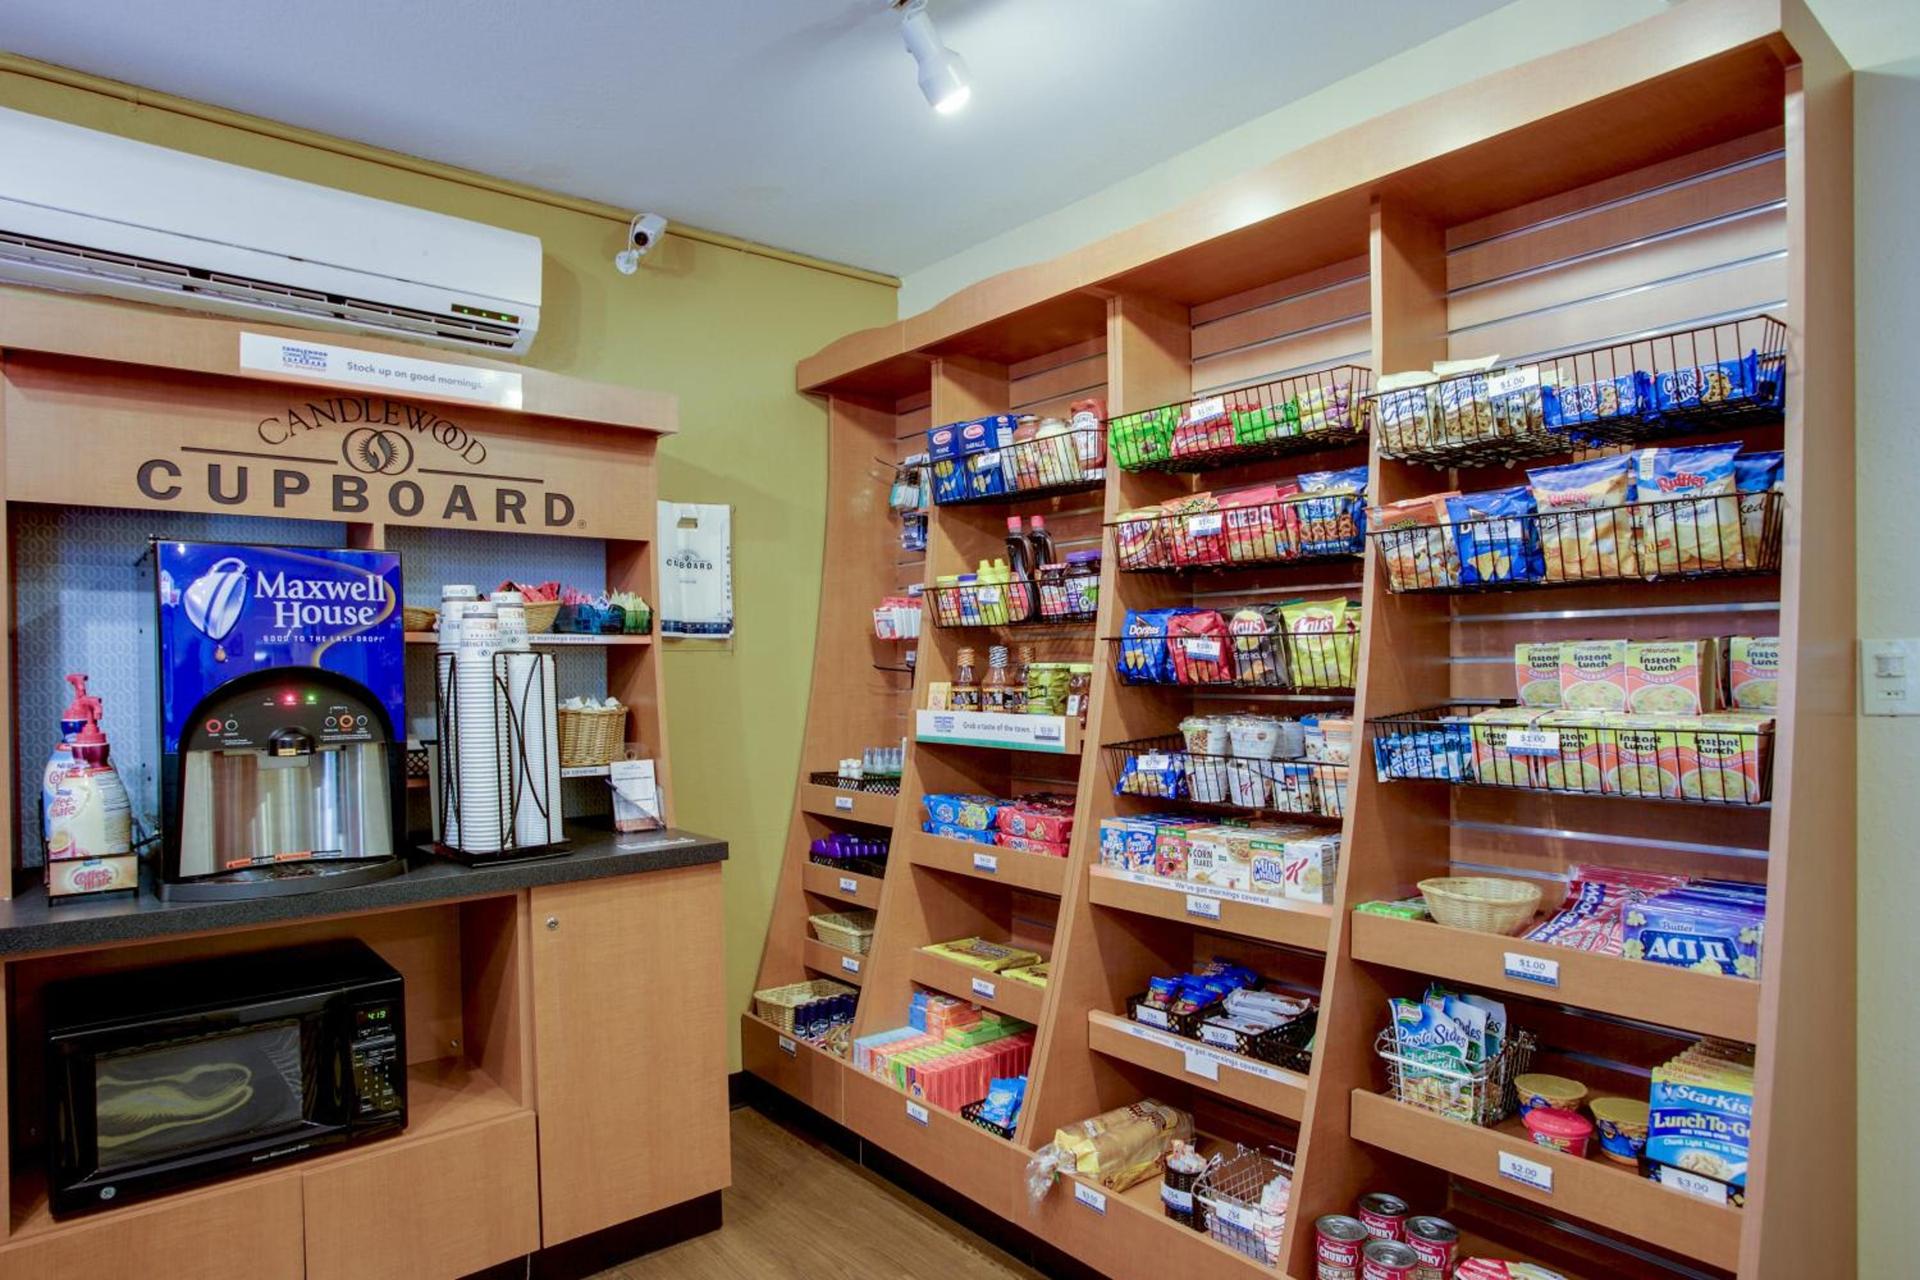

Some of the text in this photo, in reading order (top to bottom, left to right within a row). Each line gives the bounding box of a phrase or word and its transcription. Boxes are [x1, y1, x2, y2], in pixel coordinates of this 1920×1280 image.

[347, 361, 376, 373] Stock
[378, 367, 392, 378] up
[394, 370, 407, 379] on
[409, 372, 435, 383] good
[1500, 375, 1525, 390] $1.00
[257, 396, 487, 466] CANDLEWOOD
[1656, 471, 1708, 493] Ruffles
[136, 458, 576, 528] CUPBOARD
[254, 570, 387, 602] Maxwell
[273, 600, 374, 628] House
[1128, 624, 1160, 636] Doritos
[294, 634, 305, 642] TO
[309, 635, 326, 643] THE
[539, 635, 568, 643] mornings
[1574, 653, 1612, 661] Instant
[1640, 655, 1681, 664] Instant
[1746, 650, 1779, 659] Insta
[1578, 660, 1609, 669] Lunch
[1644, 664, 1677, 672] Lunch
[1751, 658, 1779, 666] Lunc
[962, 720, 976, 730] Grab
[981, 722, 996, 730] taste
[997, 722, 1003, 731] of
[1004, 723, 1014, 731] the
[1520, 734, 1546, 744] $1.00
[1560, 733, 1588, 741] stant
[1619, 733, 1662, 744] Instant
[1693, 736, 1740, 747] Instant
[1560, 740, 1585, 748] unch
[1623, 742, 1657, 751] Lunch
[1698, 747, 1735, 756] Lunch
[1193, 849, 1213, 859] CORN
[1286, 858, 1309, 885] K
[1174, 881, 1196, 891] We've
[1196, 886, 1208, 894] got
[1209, 888, 1240, 899] mornings
[1662, 921, 1693, 932] Butter
[1647, 936, 1730, 962] ACT II
[1519, 958, 1546, 970] $1.00
[1434, 1024, 1467, 1048] Sides
[1206, 1051, 1241, 1066] mornings
[1676, 1085, 1753, 1116] StarKis
[1663, 1138, 1684, 1146] Chunk
[1685, 1139, 1703, 1149] Light
[1704, 1141, 1721, 1150] Tuna
[1510, 1162, 1537, 1177] $2.00
[1676, 1176, 1709, 1193] $3.00
[1319, 1246, 1354, 1265] CHUNKY
